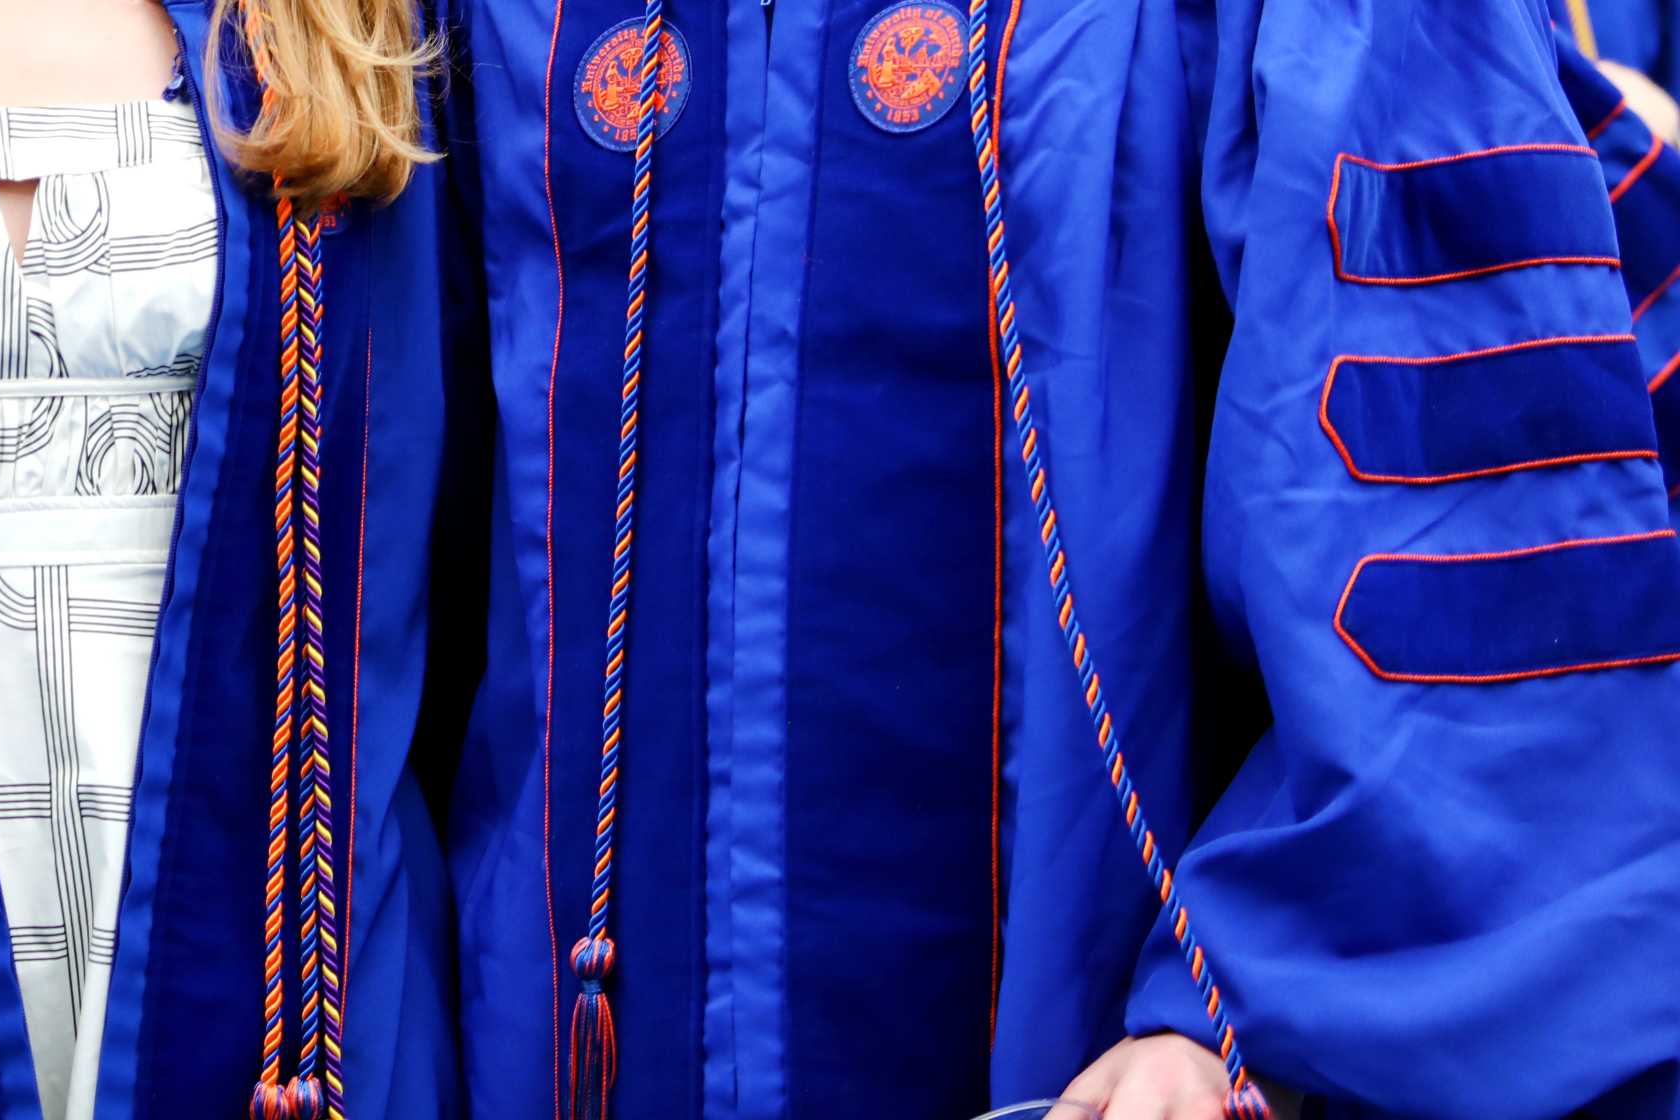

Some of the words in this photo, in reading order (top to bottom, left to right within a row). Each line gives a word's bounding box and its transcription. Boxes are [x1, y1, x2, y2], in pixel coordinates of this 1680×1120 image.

[857, 6, 922, 67] University
[925, 7, 944, 19] of
[940, 14, 964, 69] Florida
[581, 28, 638, 94] University
[613, 126, 638, 142] 185
[886, 107, 921, 124] 1853
